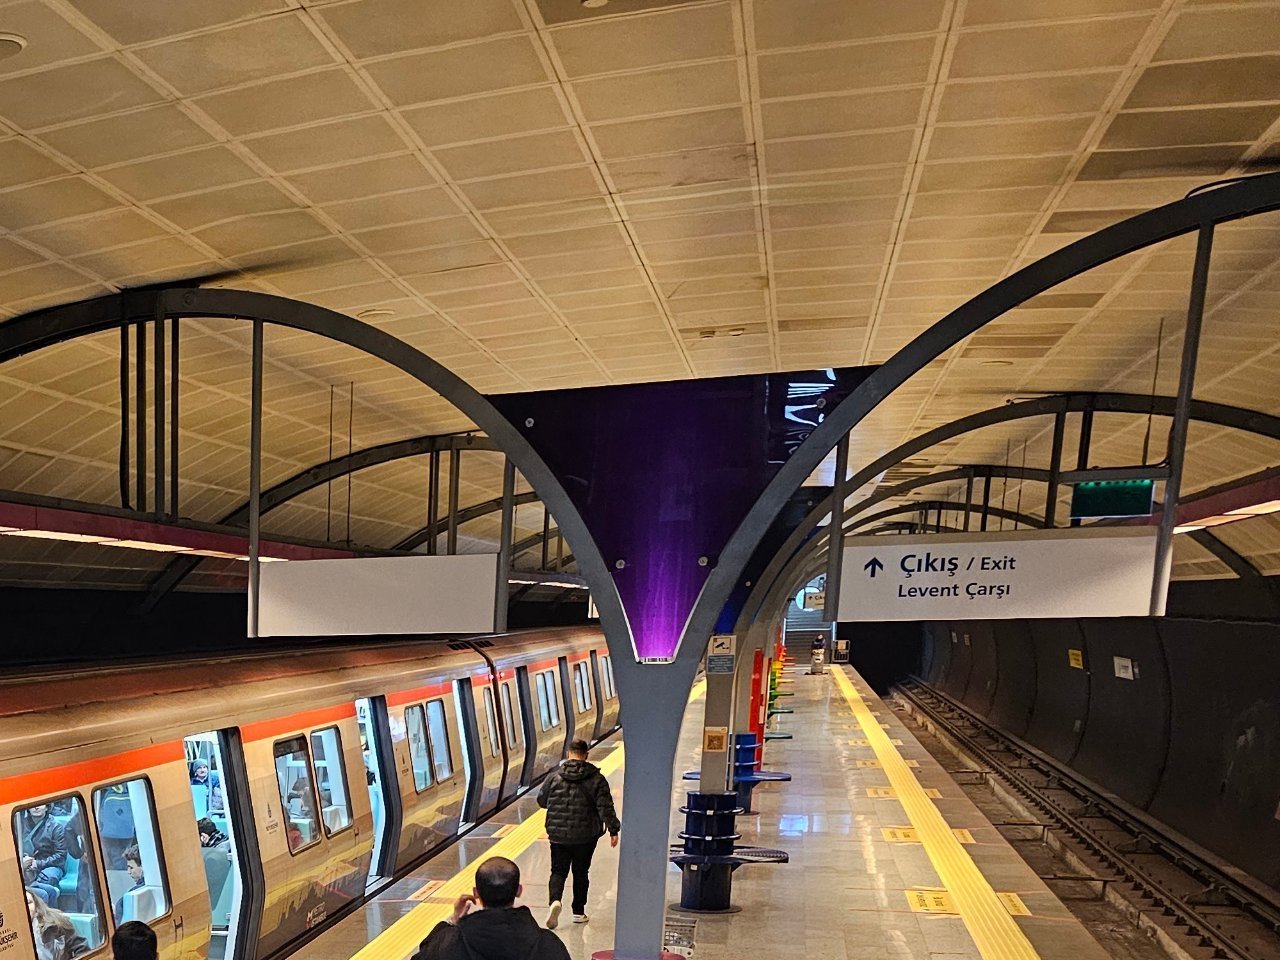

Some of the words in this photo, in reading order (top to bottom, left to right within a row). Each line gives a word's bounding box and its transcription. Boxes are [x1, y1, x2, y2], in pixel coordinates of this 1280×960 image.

[900, 552, 959, 578] Çıkış
[966, 557, 974, 571] /
[981, 555, 1017, 571] Exit
[898, 583, 960, 598] Levent
[965, 582, 1011, 600] Çarşı
